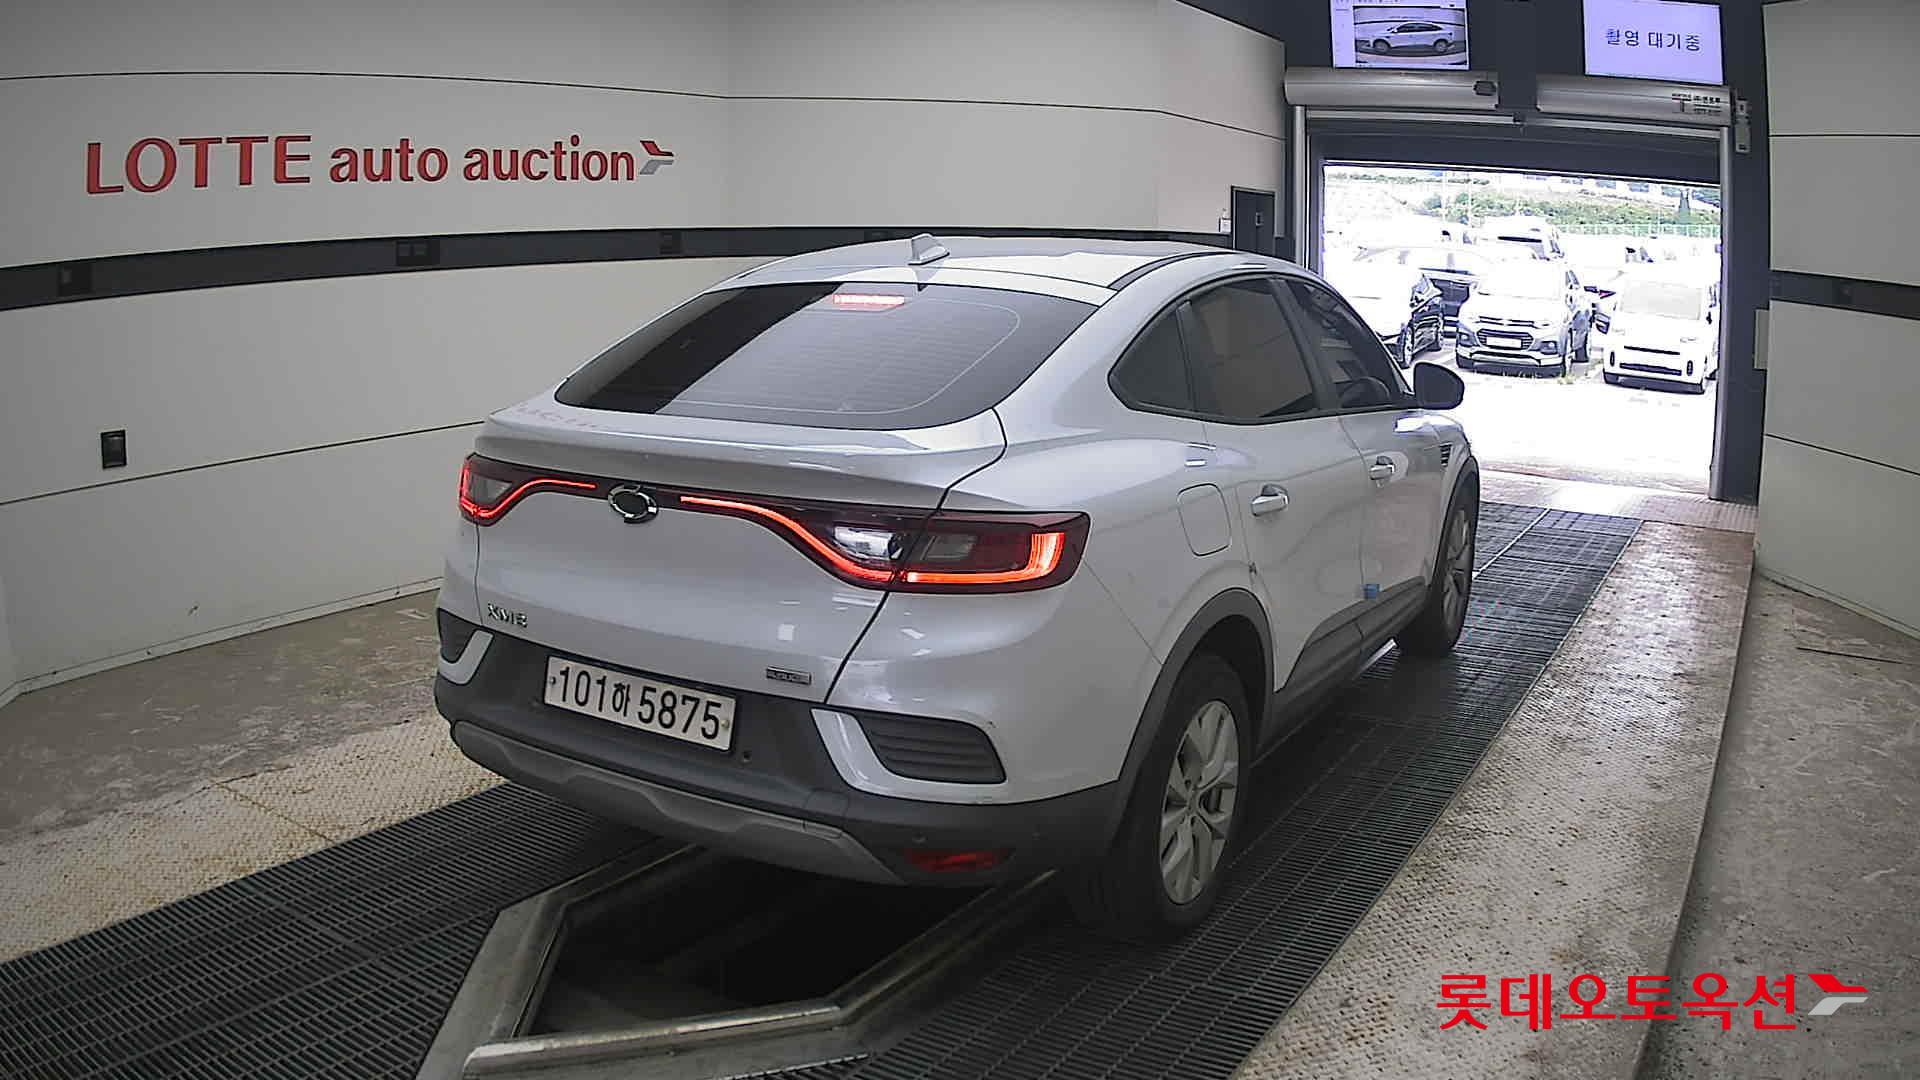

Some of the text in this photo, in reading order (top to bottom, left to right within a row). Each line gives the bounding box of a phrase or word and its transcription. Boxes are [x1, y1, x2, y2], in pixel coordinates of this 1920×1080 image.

[85, 135, 635, 194] LOTTE auto auction
